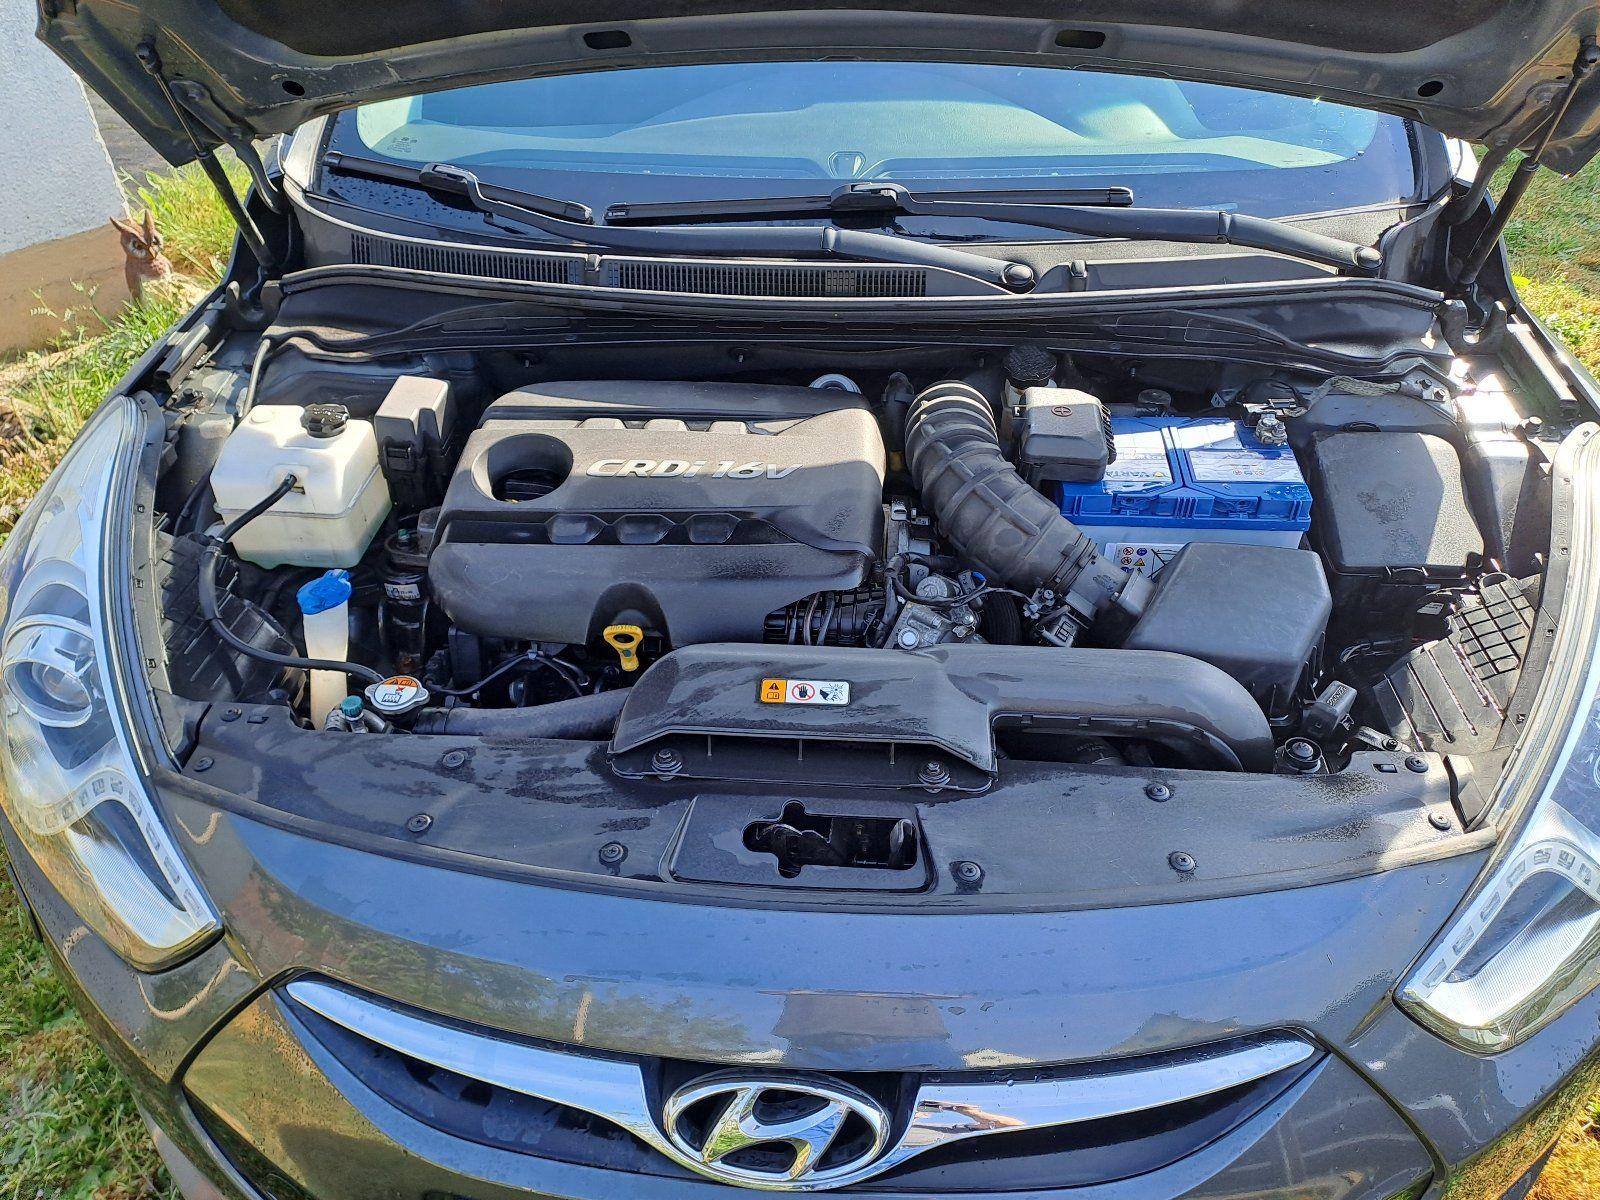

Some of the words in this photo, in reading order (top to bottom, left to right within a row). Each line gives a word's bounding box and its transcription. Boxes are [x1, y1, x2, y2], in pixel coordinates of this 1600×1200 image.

[586, 458, 708, 478] CRDi
[711, 460, 804, 480] 16V
[1105, 470, 1150, 478] VARTA
